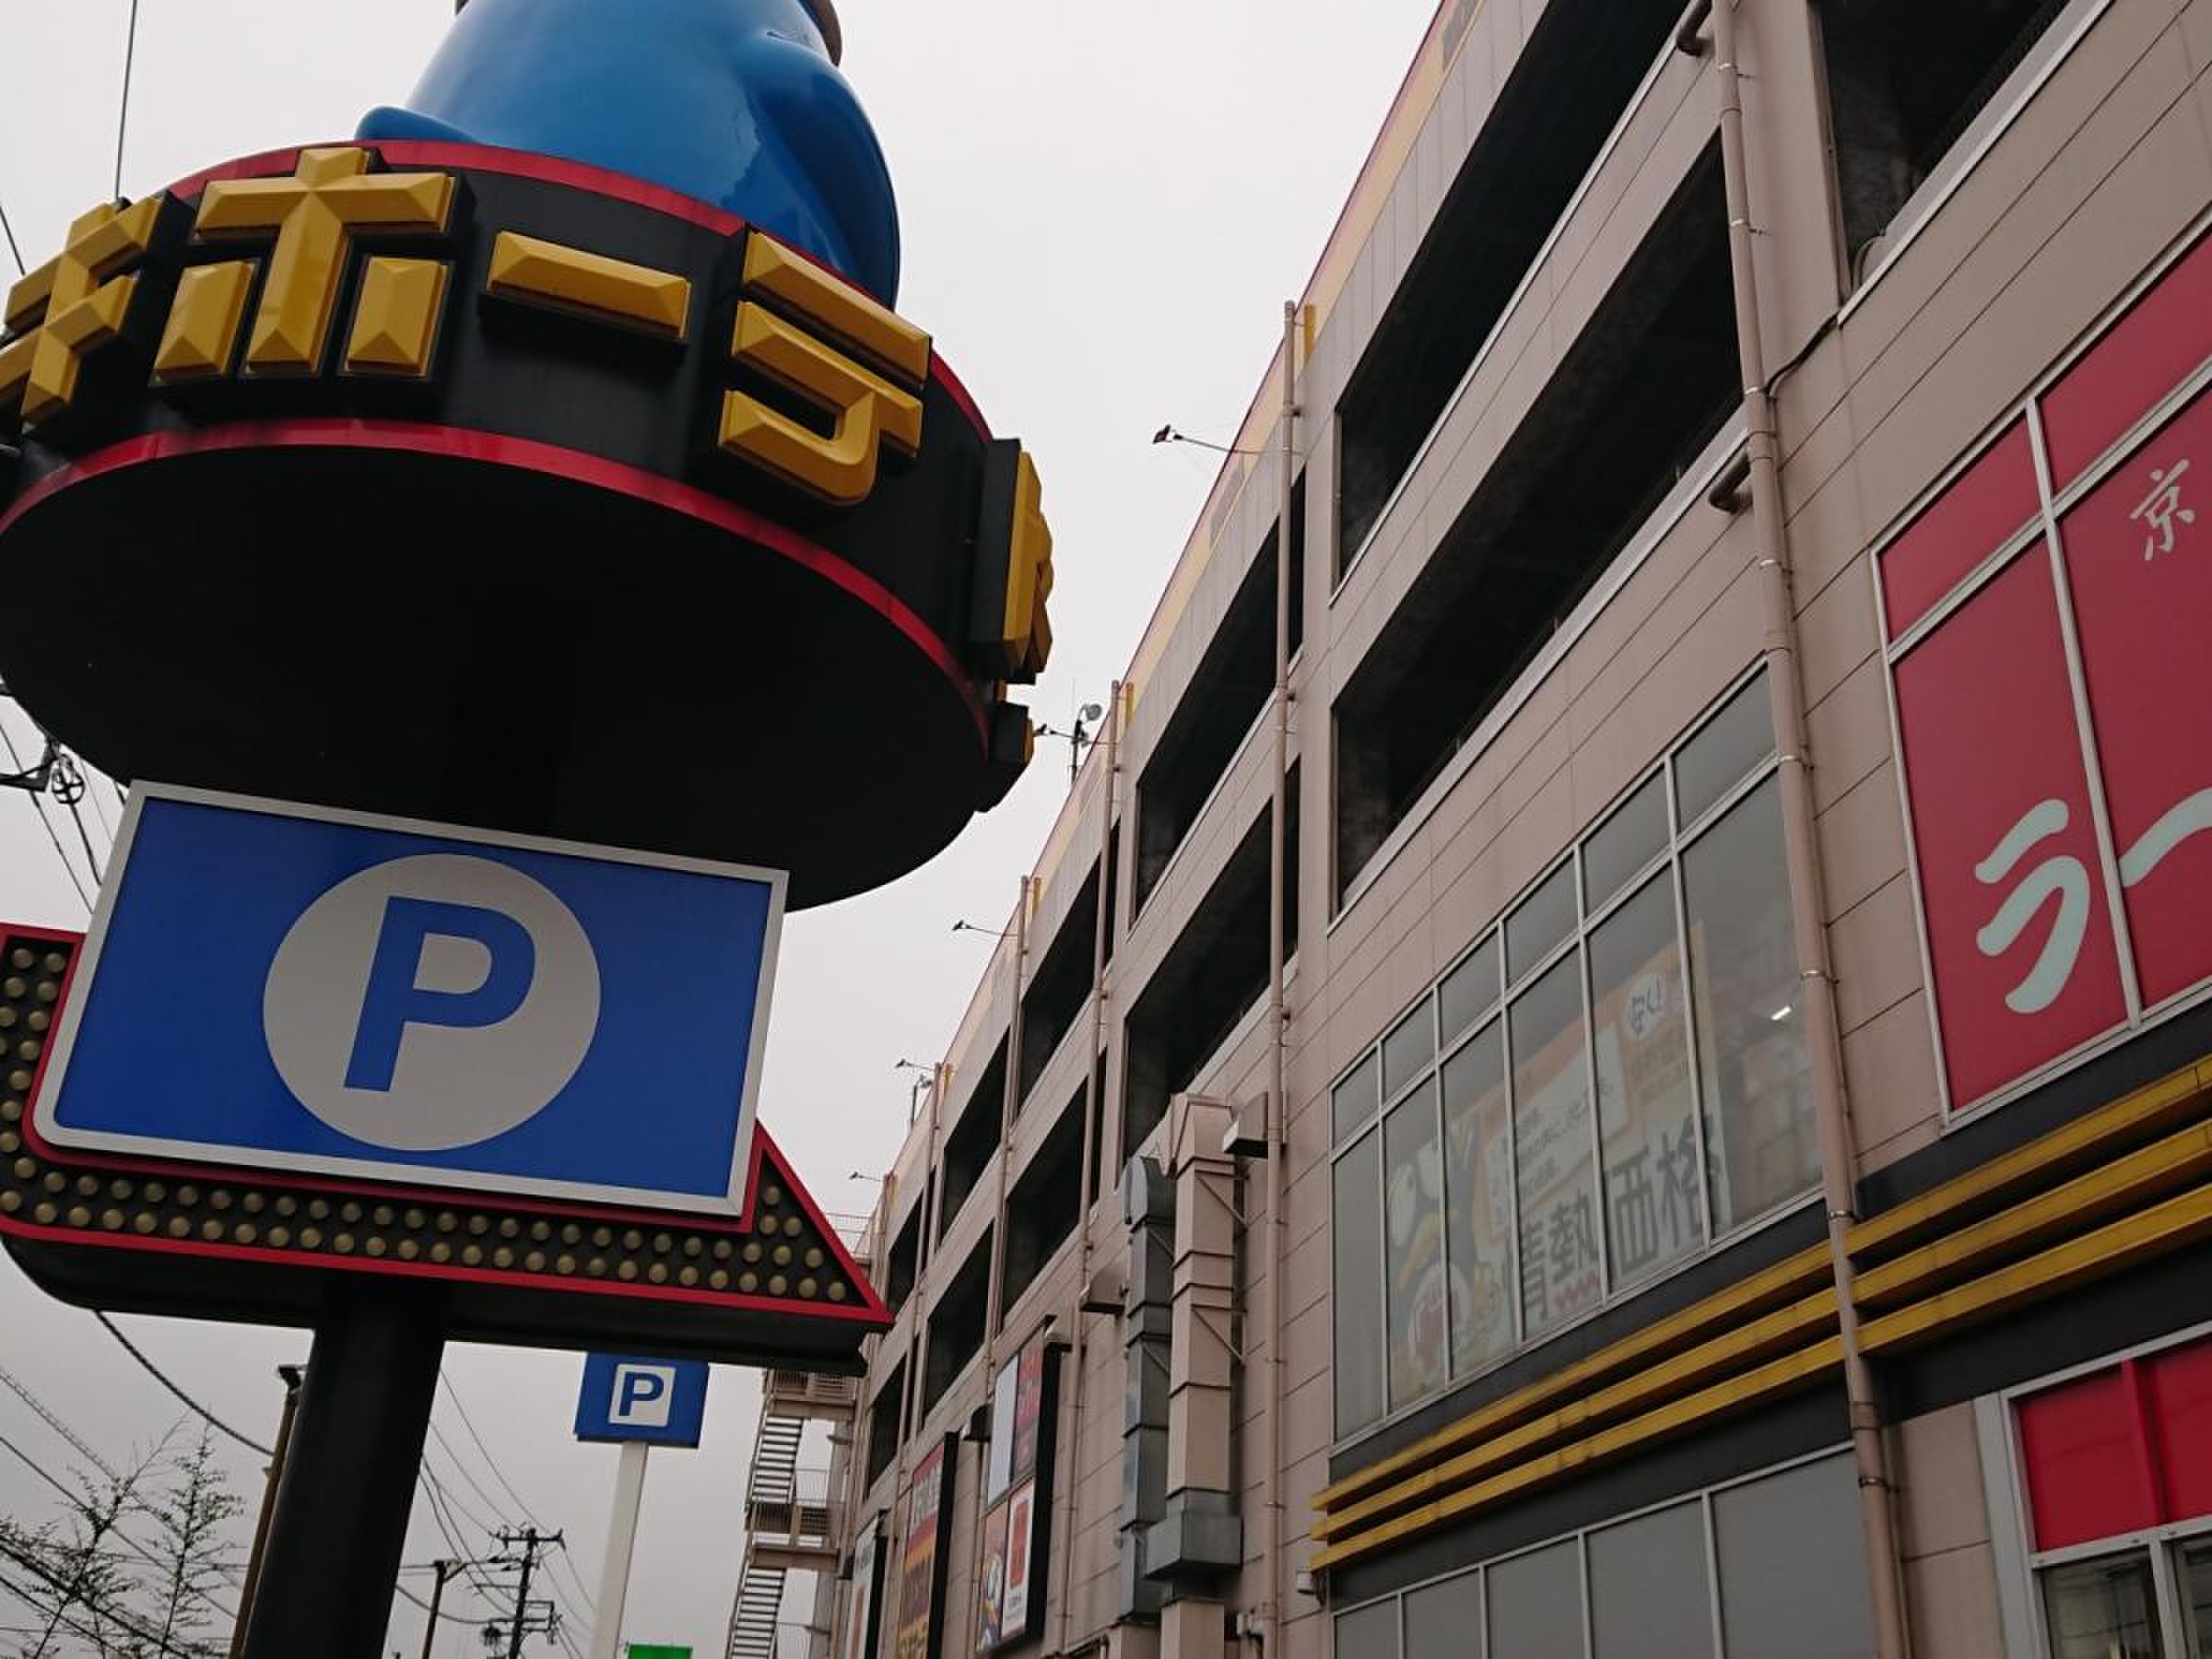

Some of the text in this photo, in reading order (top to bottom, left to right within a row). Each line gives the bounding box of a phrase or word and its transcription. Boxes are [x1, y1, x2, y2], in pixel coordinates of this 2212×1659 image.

[2129, 458, 2195, 560] 京
[344, 895, 536, 1092] P
[618, 1371, 665, 1417] P
